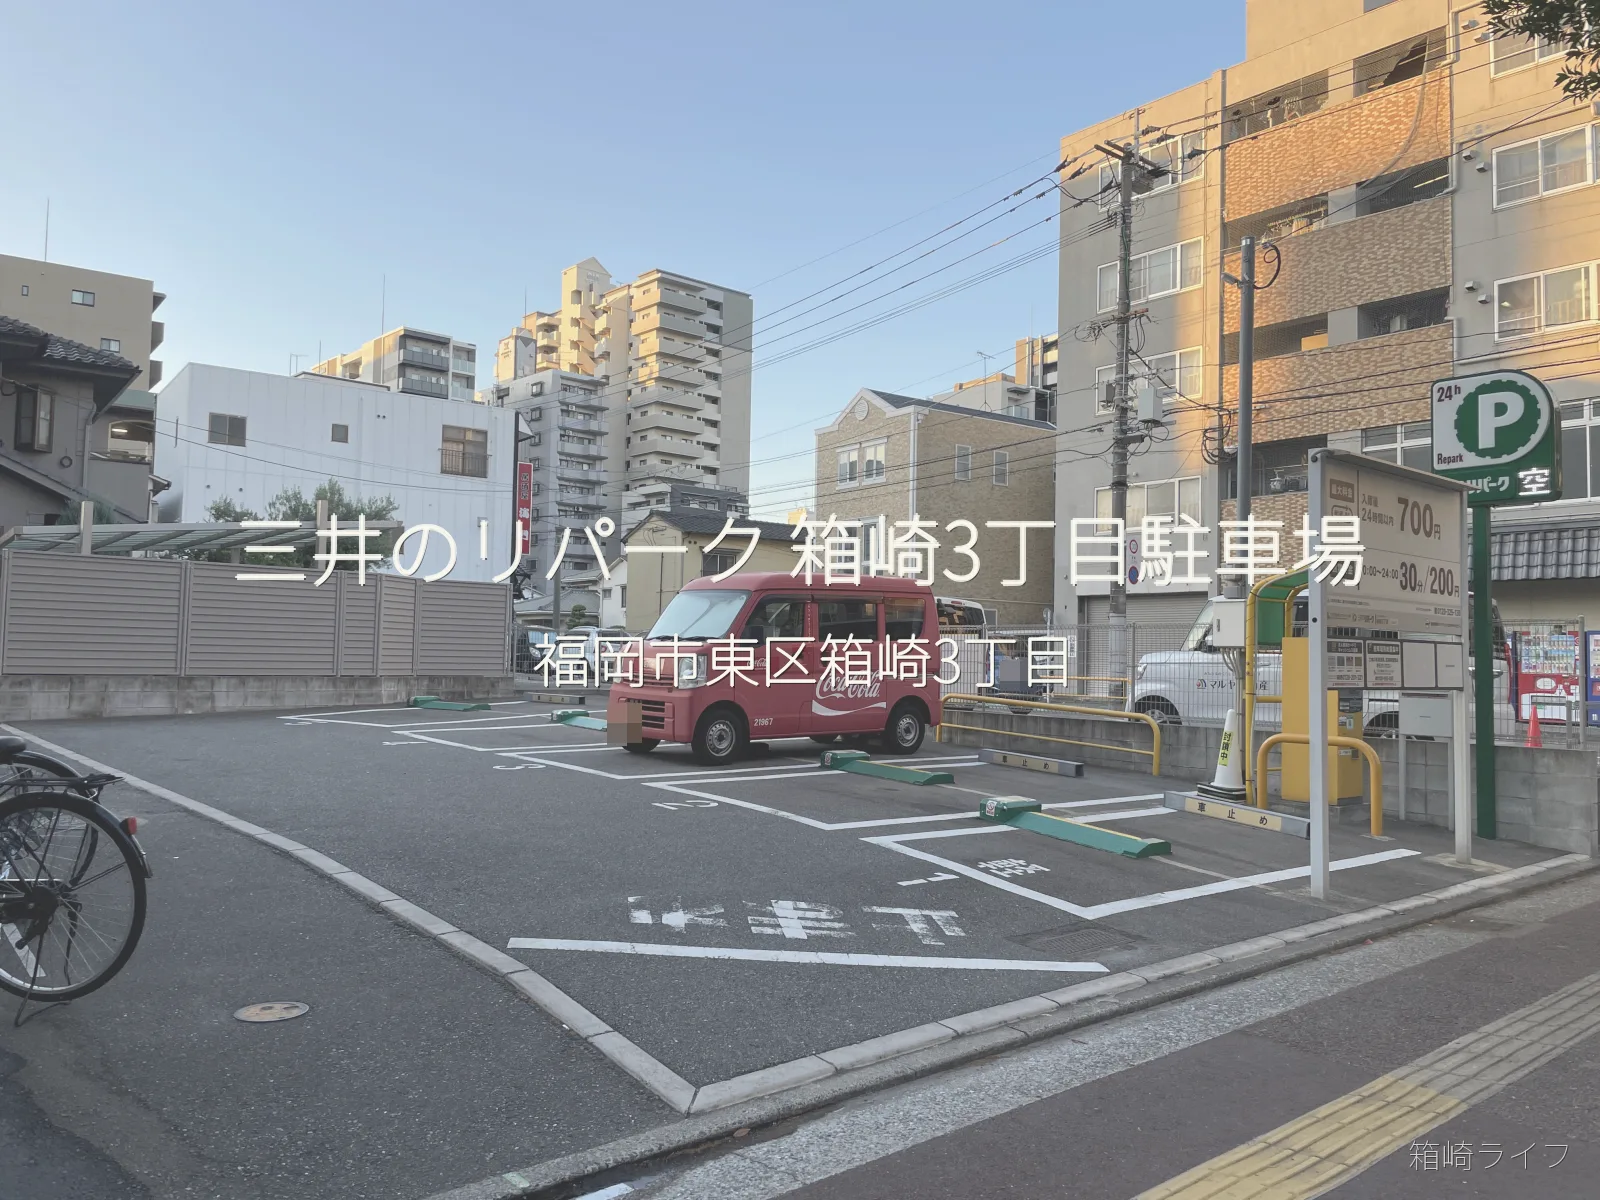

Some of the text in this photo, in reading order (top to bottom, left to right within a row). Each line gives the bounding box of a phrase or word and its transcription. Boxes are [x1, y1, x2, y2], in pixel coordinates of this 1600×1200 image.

[1437, 385, 1461, 402] 24h
[1478, 391, 1525, 449] P
[1437, 453, 1464, 465] Repark
[1517, 467, 1551, 496] 空
[1331, 483, 1353, 498] 大料金
[1397, 496, 1441, 541] 700円
[815, 669, 881, 700] CocaCola
[753, 717, 774, 727] 21967
[651, 800, 719, 811] 2
[1198, 802, 1268, 826] 車止め
[896, 872, 961, 886] 1
